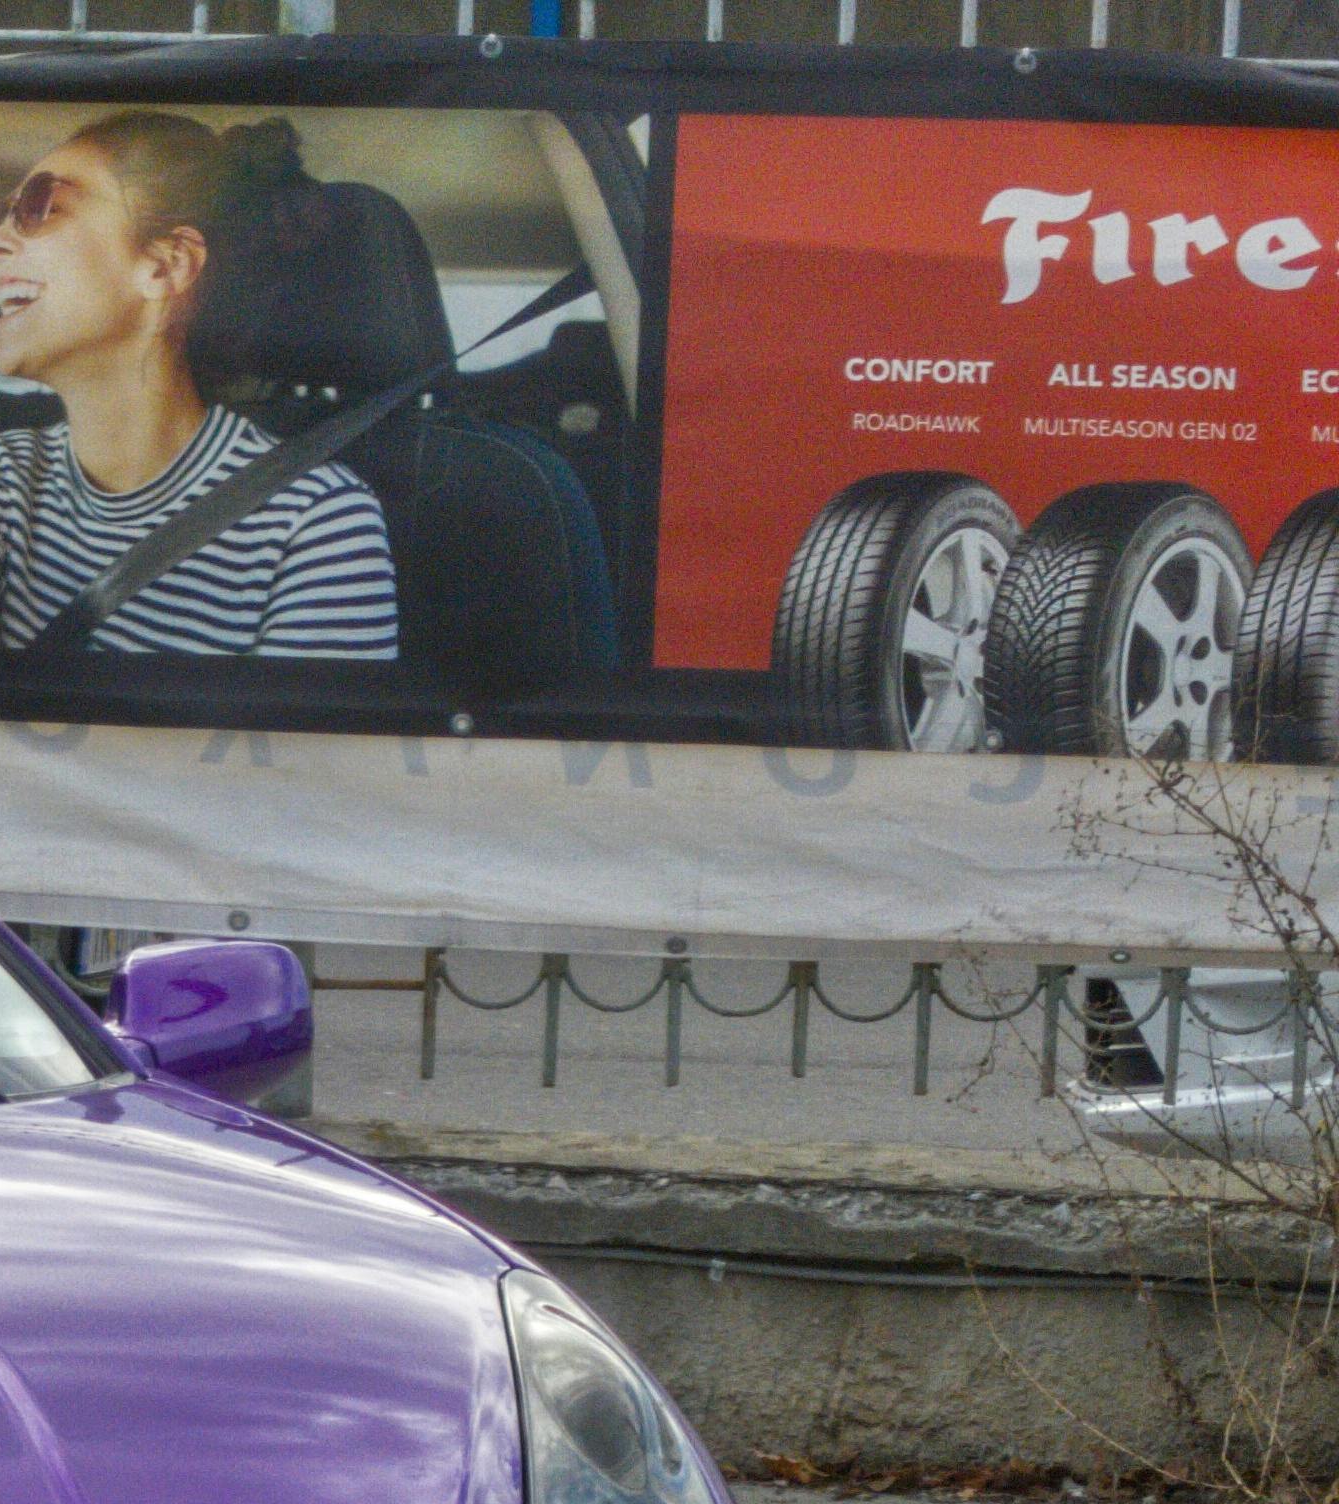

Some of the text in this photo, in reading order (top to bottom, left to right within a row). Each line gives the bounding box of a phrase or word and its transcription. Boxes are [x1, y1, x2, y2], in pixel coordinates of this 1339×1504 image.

[981, 188, 1339, 304] Fire
[845, 357, 994, 385] CONFORT
[1047, 363, 1238, 391] ALL SEASON
[852, 412, 981, 434] ROADHAWK
[1024, 417, 1258, 442] MULTISEASON GEN 02
